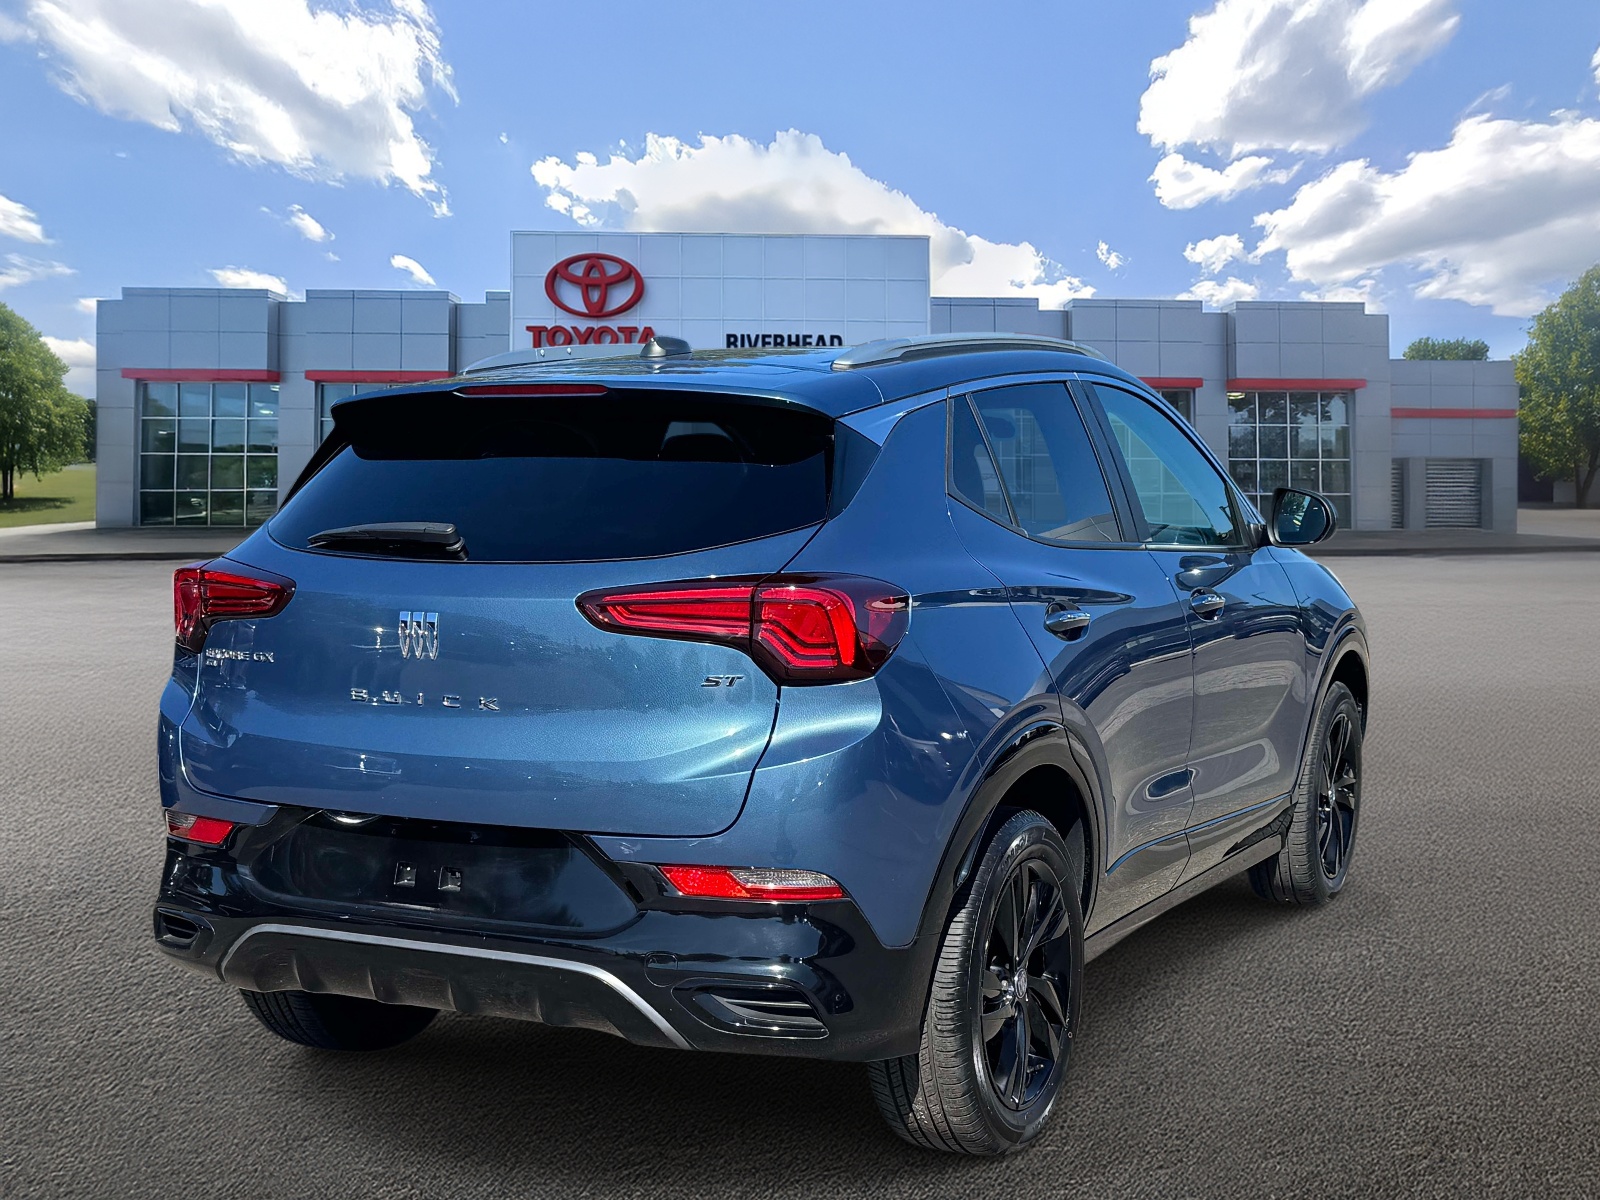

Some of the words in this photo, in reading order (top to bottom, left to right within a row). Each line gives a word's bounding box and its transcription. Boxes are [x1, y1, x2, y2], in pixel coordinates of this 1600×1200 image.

[526, 326, 655, 348] TOYOTA
[726, 334, 843, 348] RIVERHEAD
[701, 675, 745, 688] ST
[351, 688, 500, 711] BUICK
